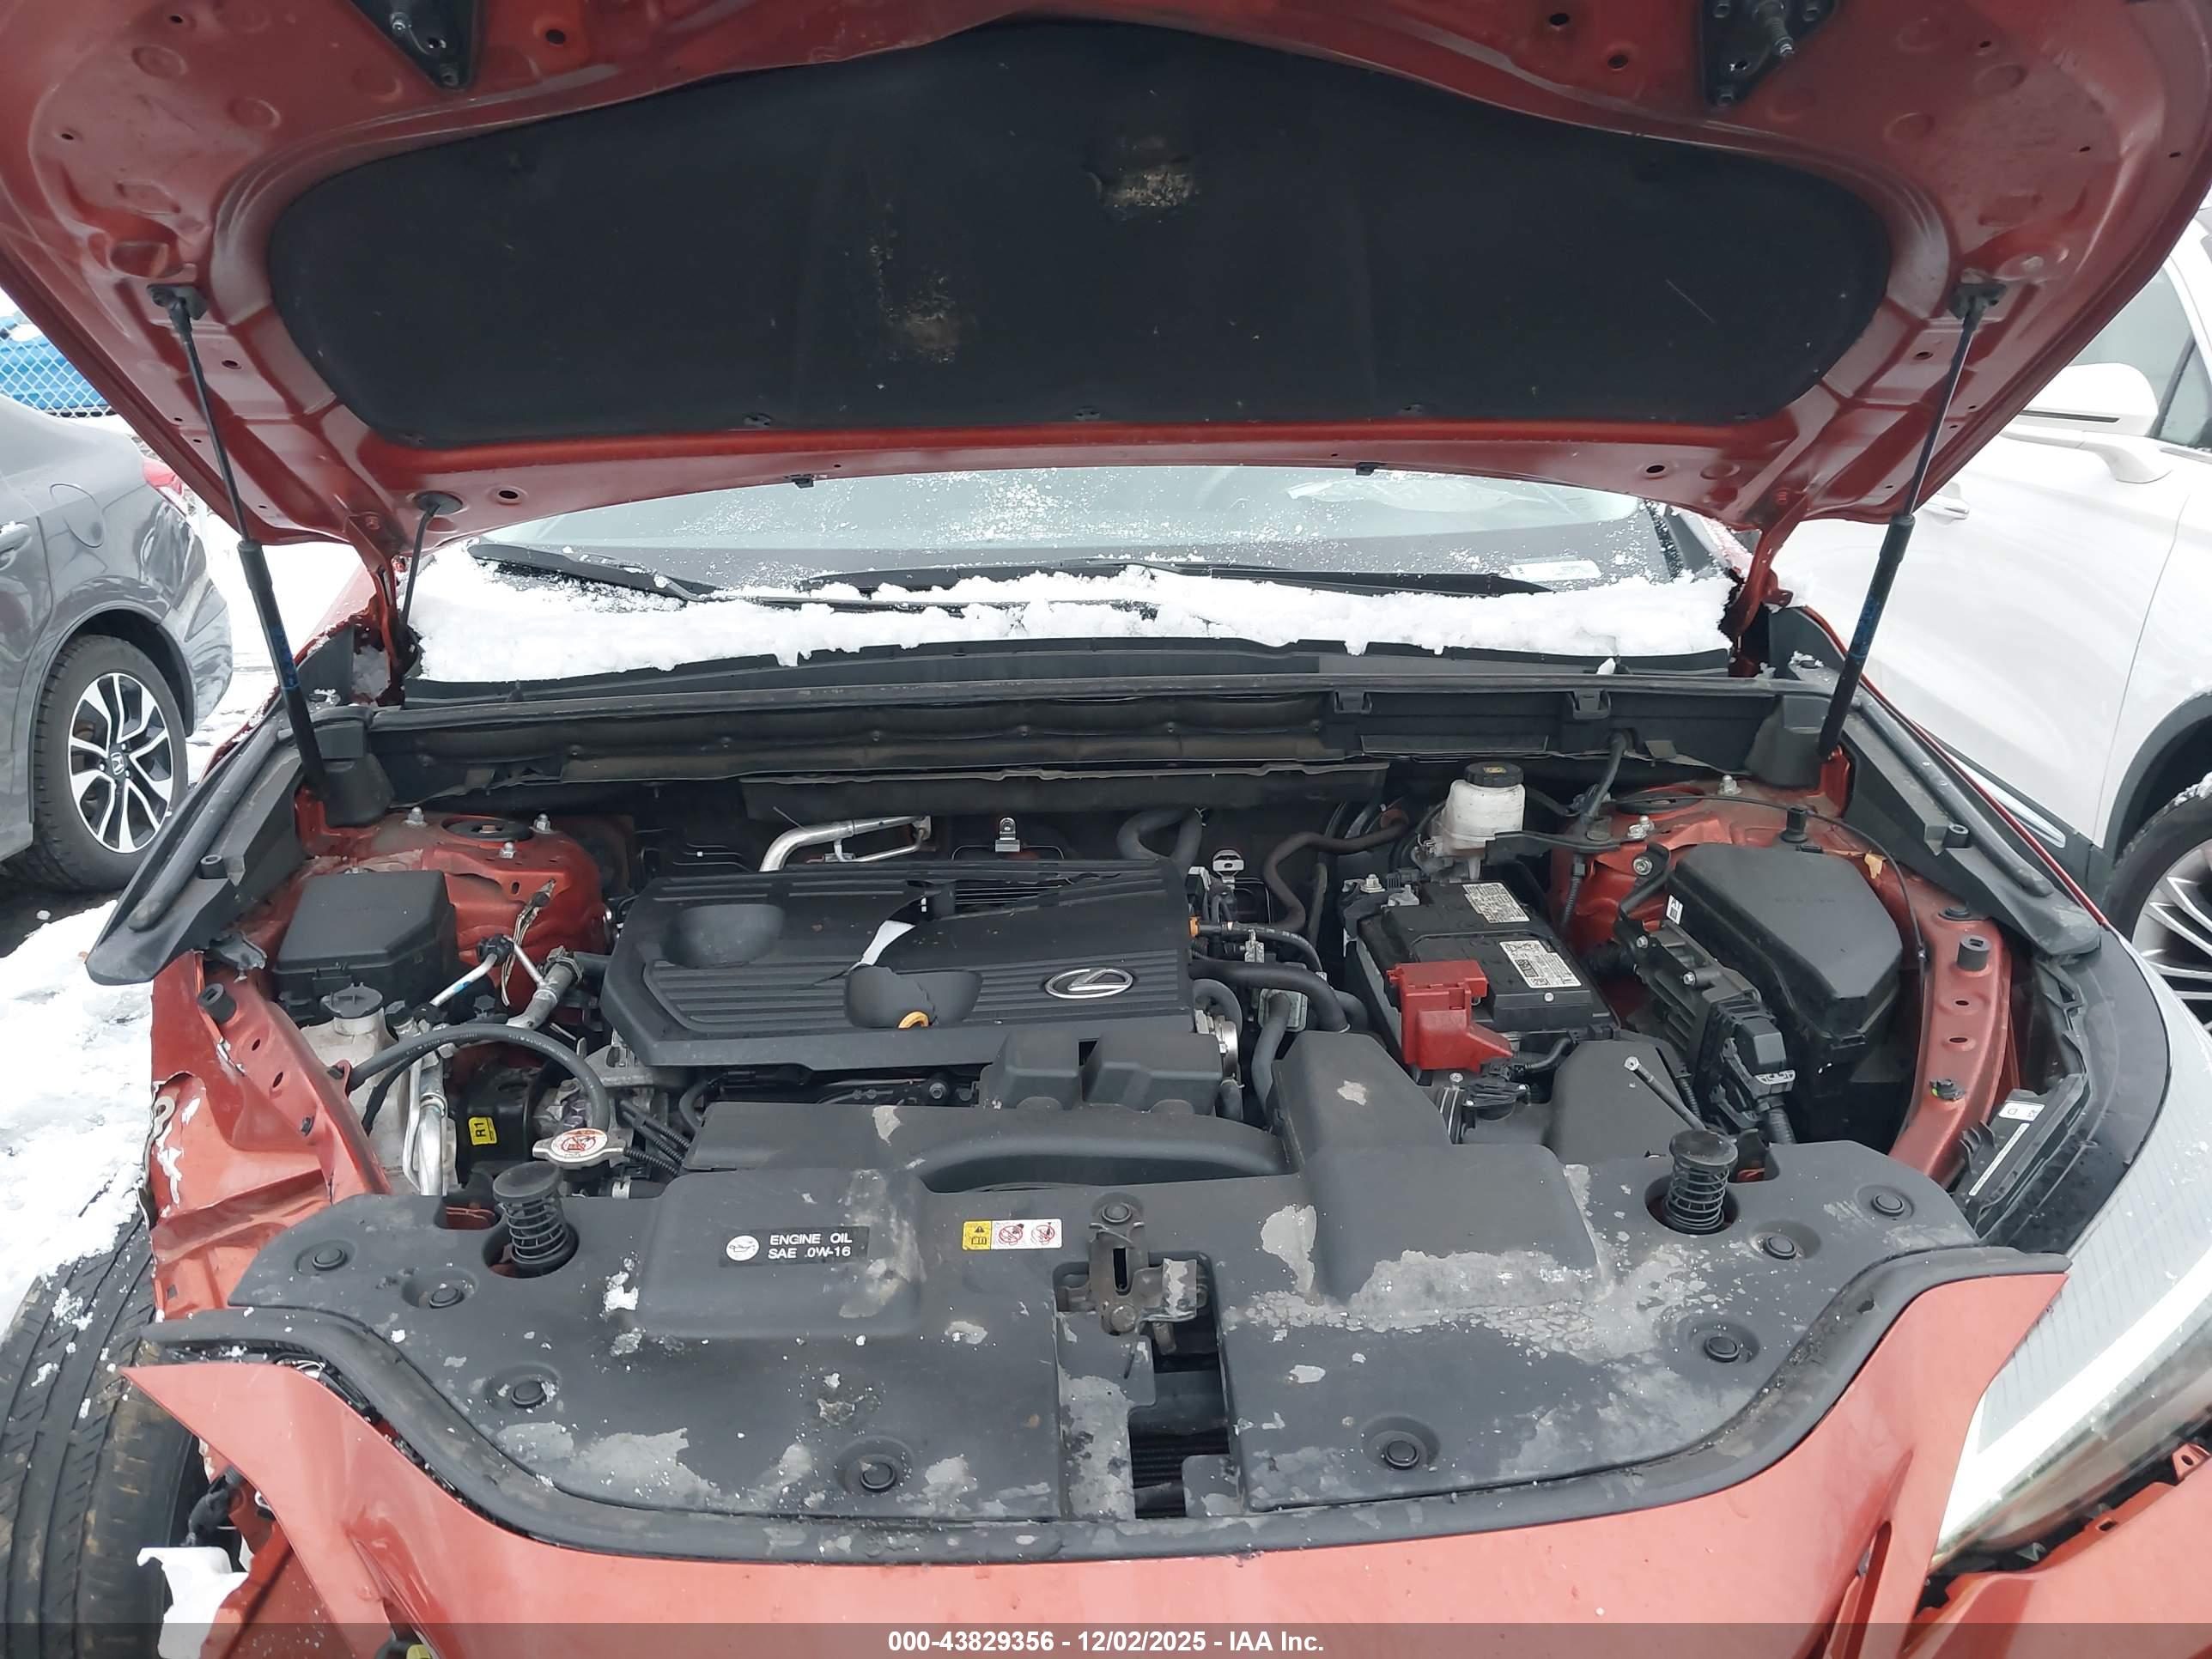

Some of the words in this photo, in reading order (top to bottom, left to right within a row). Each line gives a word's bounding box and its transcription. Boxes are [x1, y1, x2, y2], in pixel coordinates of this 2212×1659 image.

[473, 1122, 487, 1138] R1
[769, 1233, 822, 1245] ENGINE
[830, 1232, 853, 1243] OIL
[768, 1248, 798, 1260] SAE
[806, 1246, 851, 1258] 0W-16
